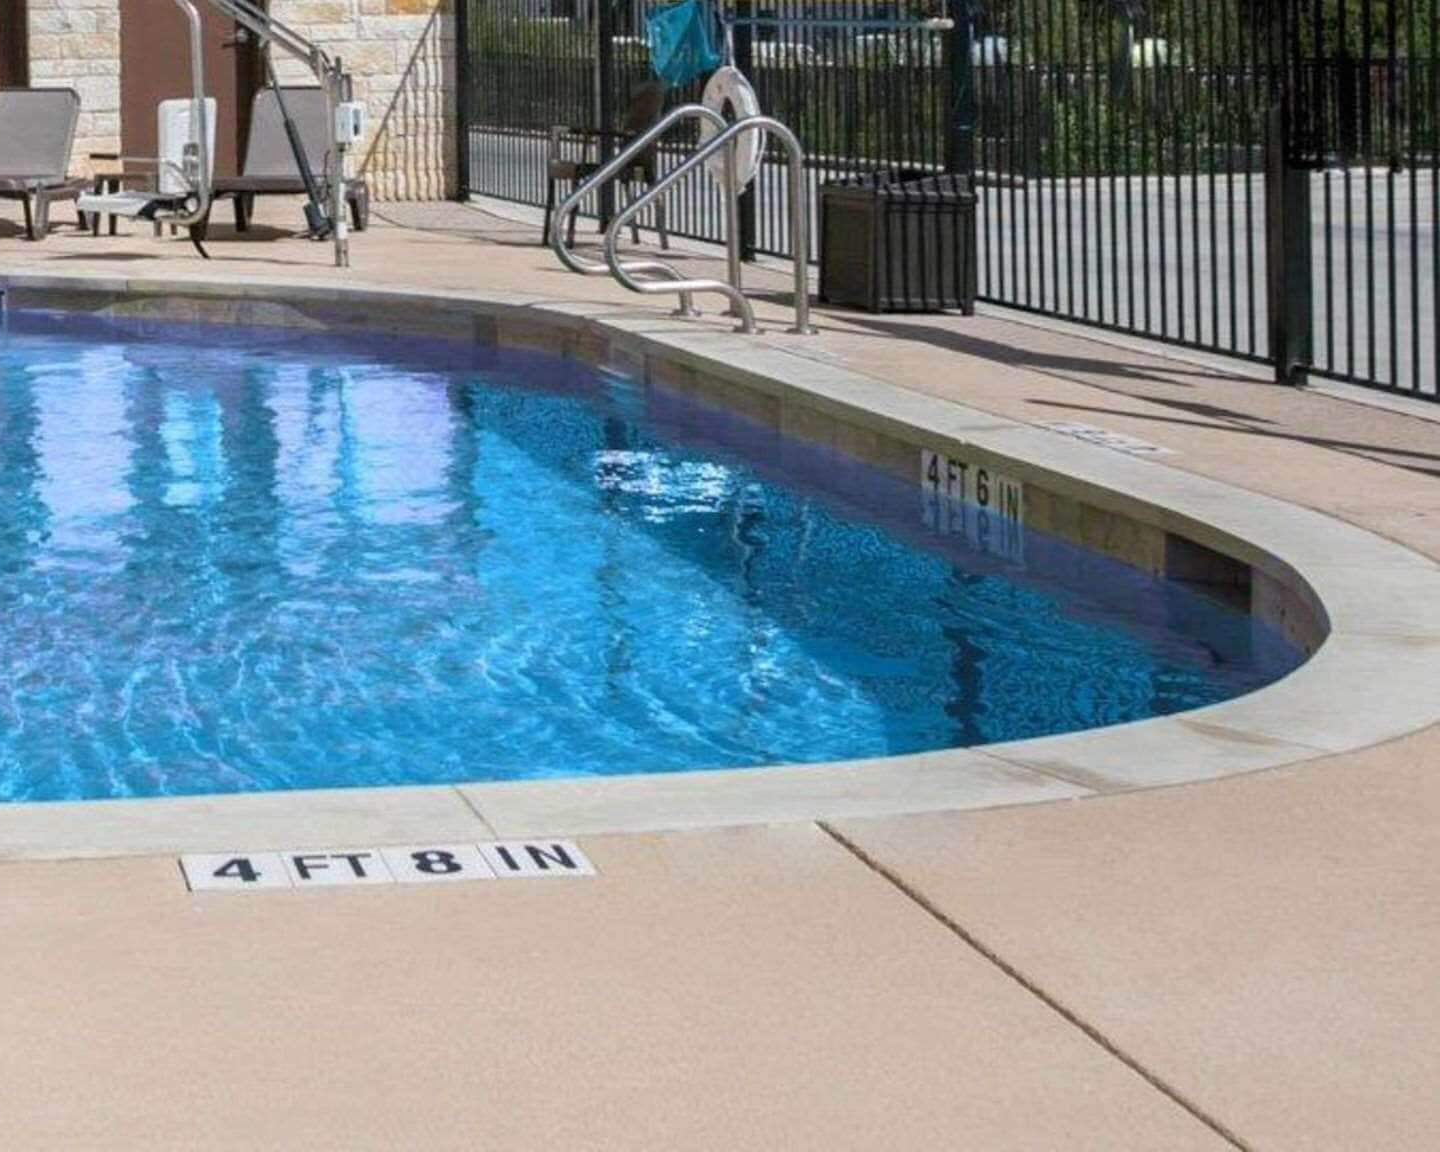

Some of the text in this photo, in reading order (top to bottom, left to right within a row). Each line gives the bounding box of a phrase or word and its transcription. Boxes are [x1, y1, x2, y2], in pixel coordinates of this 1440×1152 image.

[927, 454, 1019, 522] 4 FT 6 IN
[213, 844, 578, 883] 4 FT 8 IN
